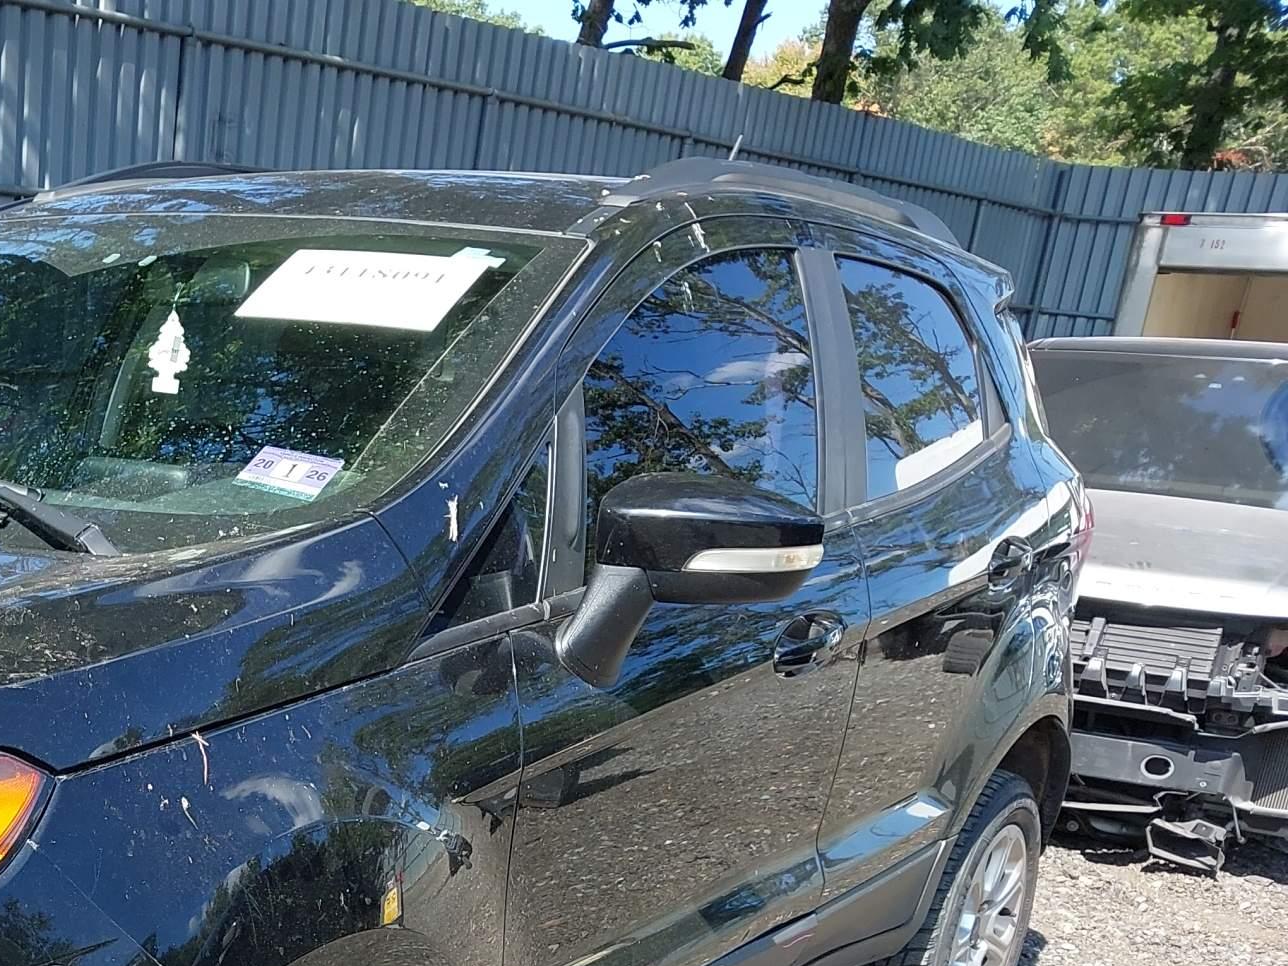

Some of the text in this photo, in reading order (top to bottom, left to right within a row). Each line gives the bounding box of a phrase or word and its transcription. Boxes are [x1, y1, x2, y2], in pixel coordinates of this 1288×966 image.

[253, 457, 275, 470] 20
[283, 463, 299, 478] 1
[305, 469, 329, 482] 26
